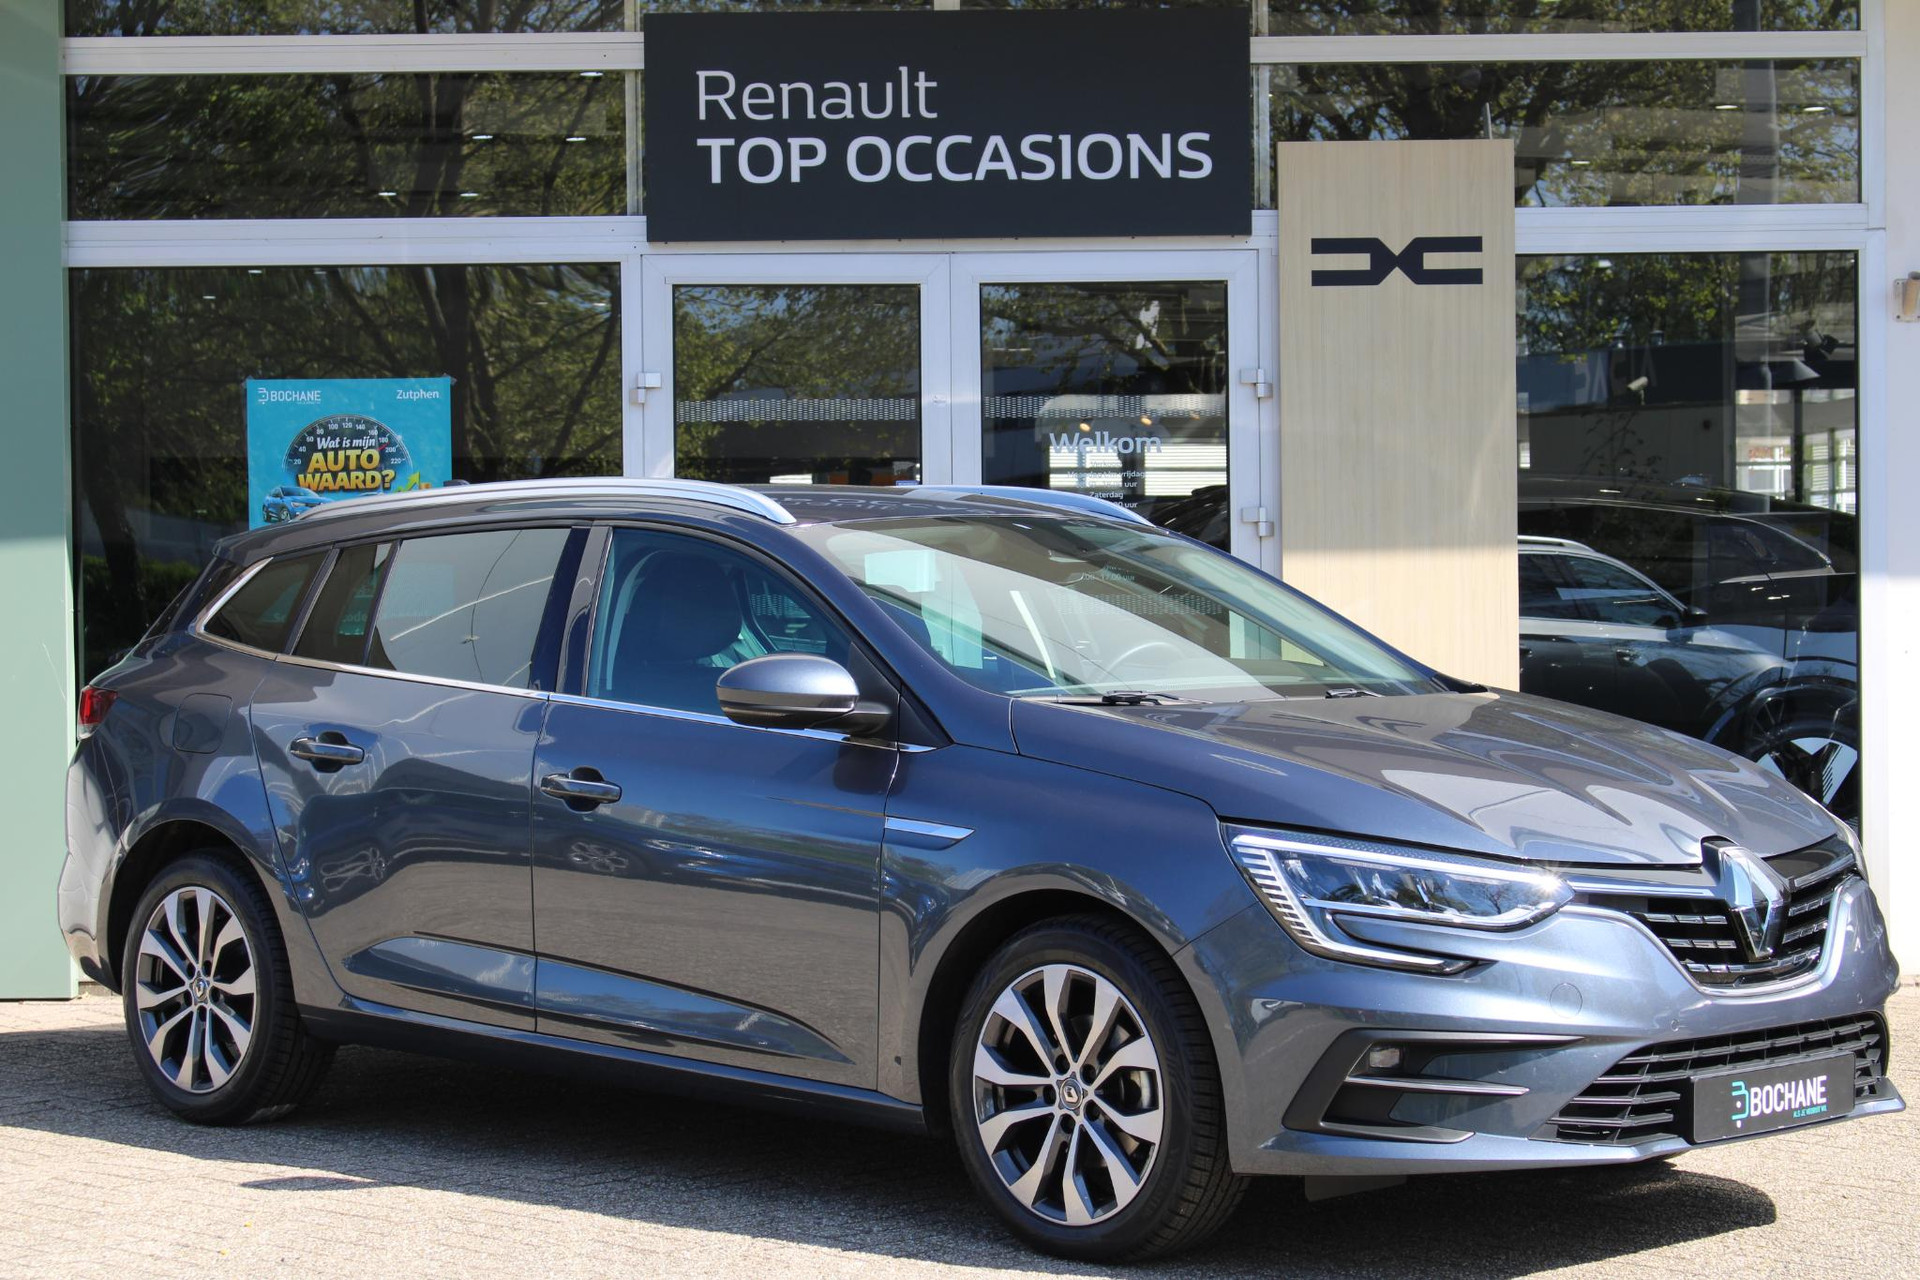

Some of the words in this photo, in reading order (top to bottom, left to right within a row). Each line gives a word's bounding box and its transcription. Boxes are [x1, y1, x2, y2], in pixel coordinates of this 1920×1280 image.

[696, 66, 937, 120] Renault
[696, 137, 827, 184] TOP
[846, 131, 1213, 183] OCCASIONS
[270, 390, 321, 402] BOCHANE
[396, 389, 439, 401] Zutphen
[316, 436, 340, 450] Wat
[342, 436, 350, 448] is
[352, 436, 376, 450] mijn
[1050, 431, 1162, 454] Welkom
[307, 449, 380, 473] AUTO
[298, 469, 396, 492] WAARD?
[1119, 470, 1145, 479] vrijdag
[1090, 491, 1124, 500] Zaterdag
[1750, 1075, 1827, 1117] BOCHANE
